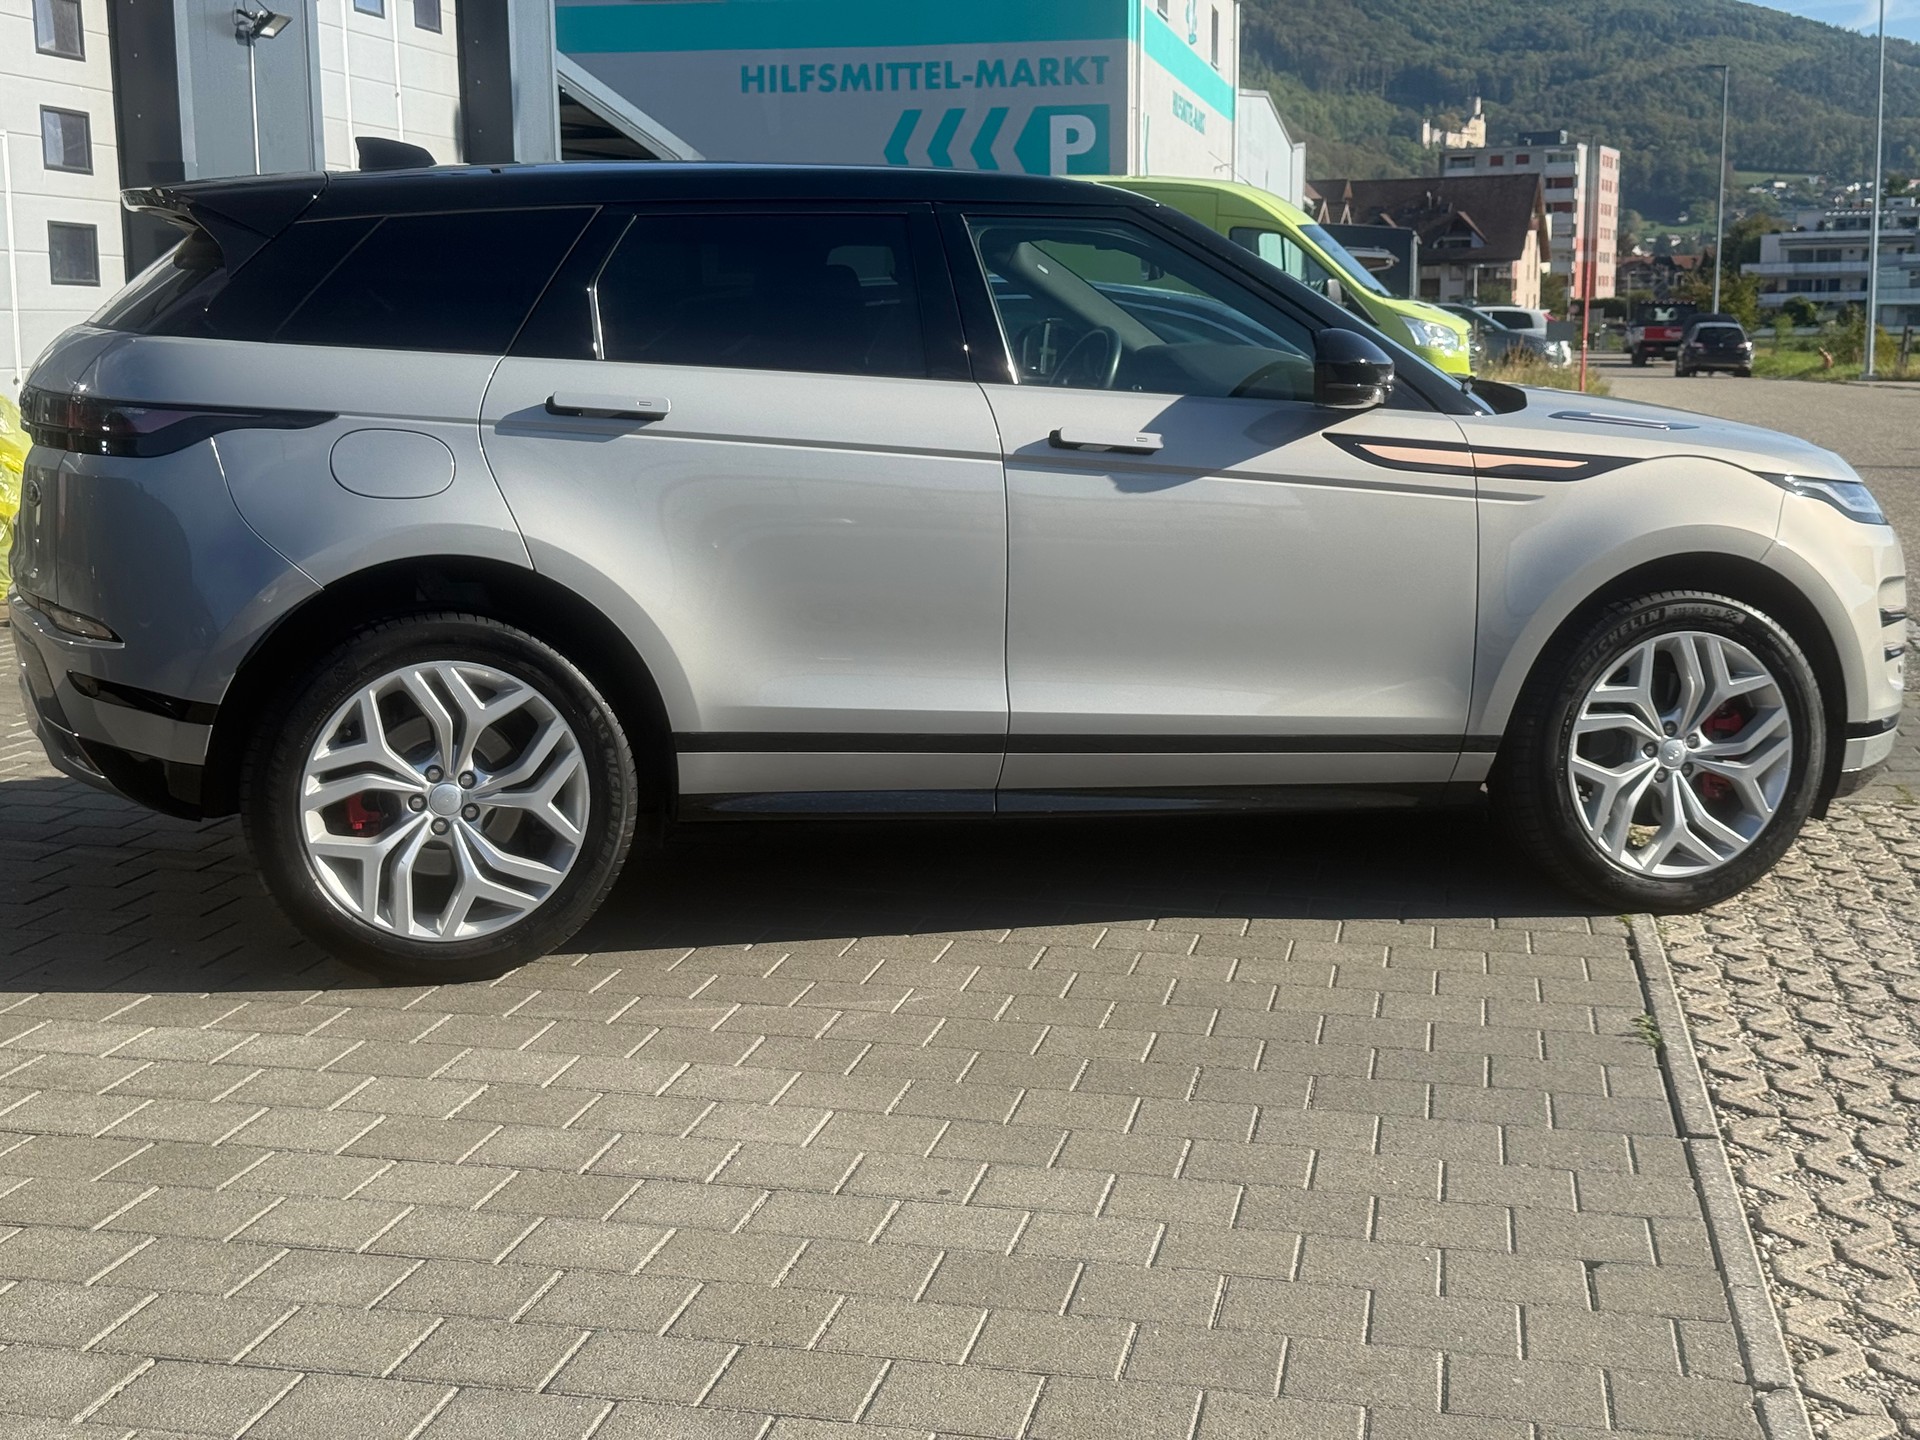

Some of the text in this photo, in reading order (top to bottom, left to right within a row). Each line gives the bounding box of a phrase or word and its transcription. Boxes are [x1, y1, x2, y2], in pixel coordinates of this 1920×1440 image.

[741, 55, 1110, 94] HILFSMITTEL-MARKT
[1050, 114, 1097, 177] P
[1579, 608, 1661, 669] MICHELIN
[598, 747, 622, 857] MICHELIN
